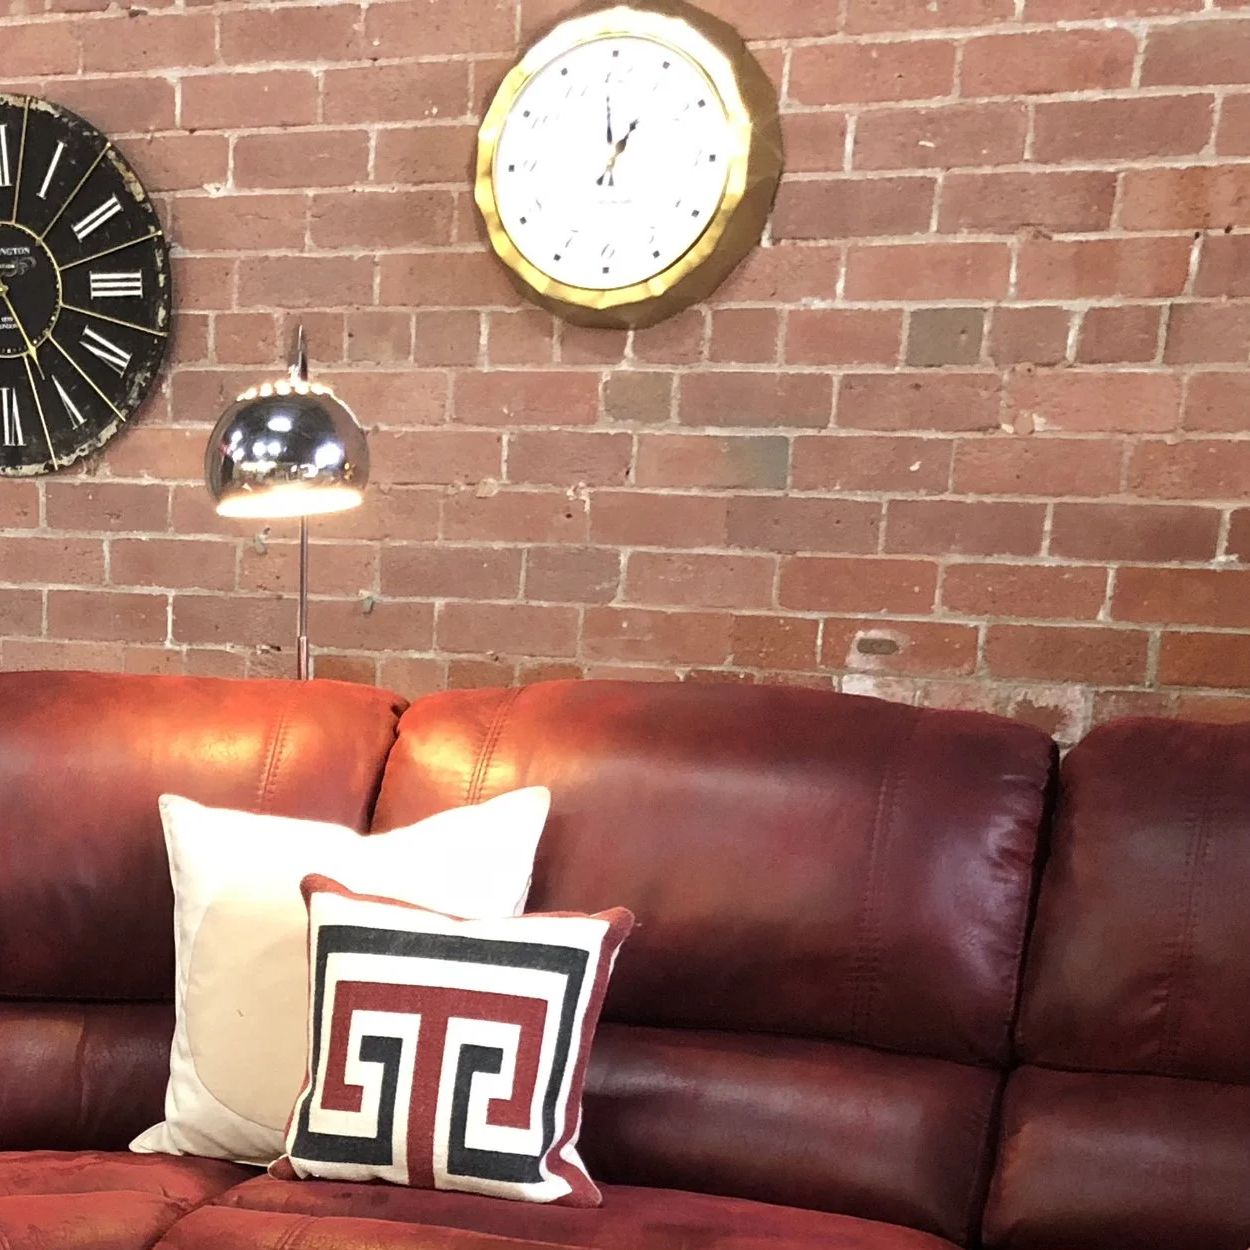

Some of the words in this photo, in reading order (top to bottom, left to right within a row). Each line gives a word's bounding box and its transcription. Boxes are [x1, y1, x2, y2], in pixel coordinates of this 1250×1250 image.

[37, 140, 67, 199] I
[70, 192, 123, 242] II
[90, 270, 143, 299] III
[78, 323, 134, 378] IV
[0, 387, 26, 446] VI
[52, 373, 88, 430] V
